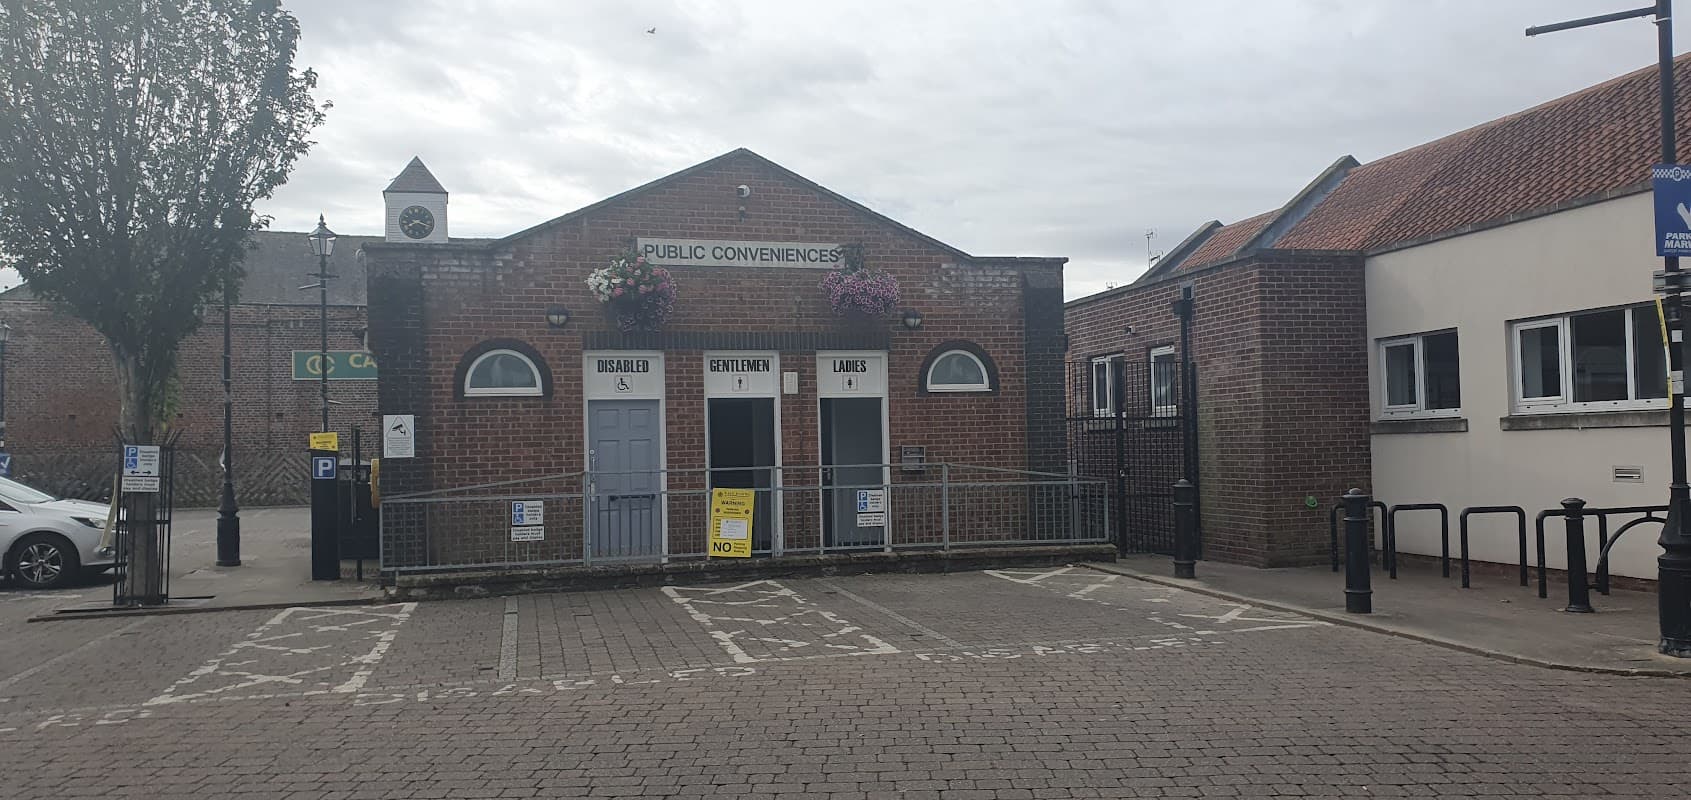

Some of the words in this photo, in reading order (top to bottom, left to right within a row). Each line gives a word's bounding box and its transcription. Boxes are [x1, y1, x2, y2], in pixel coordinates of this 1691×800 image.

[644, 244, 706, 260] PUBLIC
[711, 246, 839, 263] CONVENIENCES
[597, 359, 649, 373] DISABLED
[709, 359, 770, 373] GENTLEMEN
[833, 359, 867, 373] LADIES
[318, 459, 333, 477] P
[713, 541, 732, 553] NO
